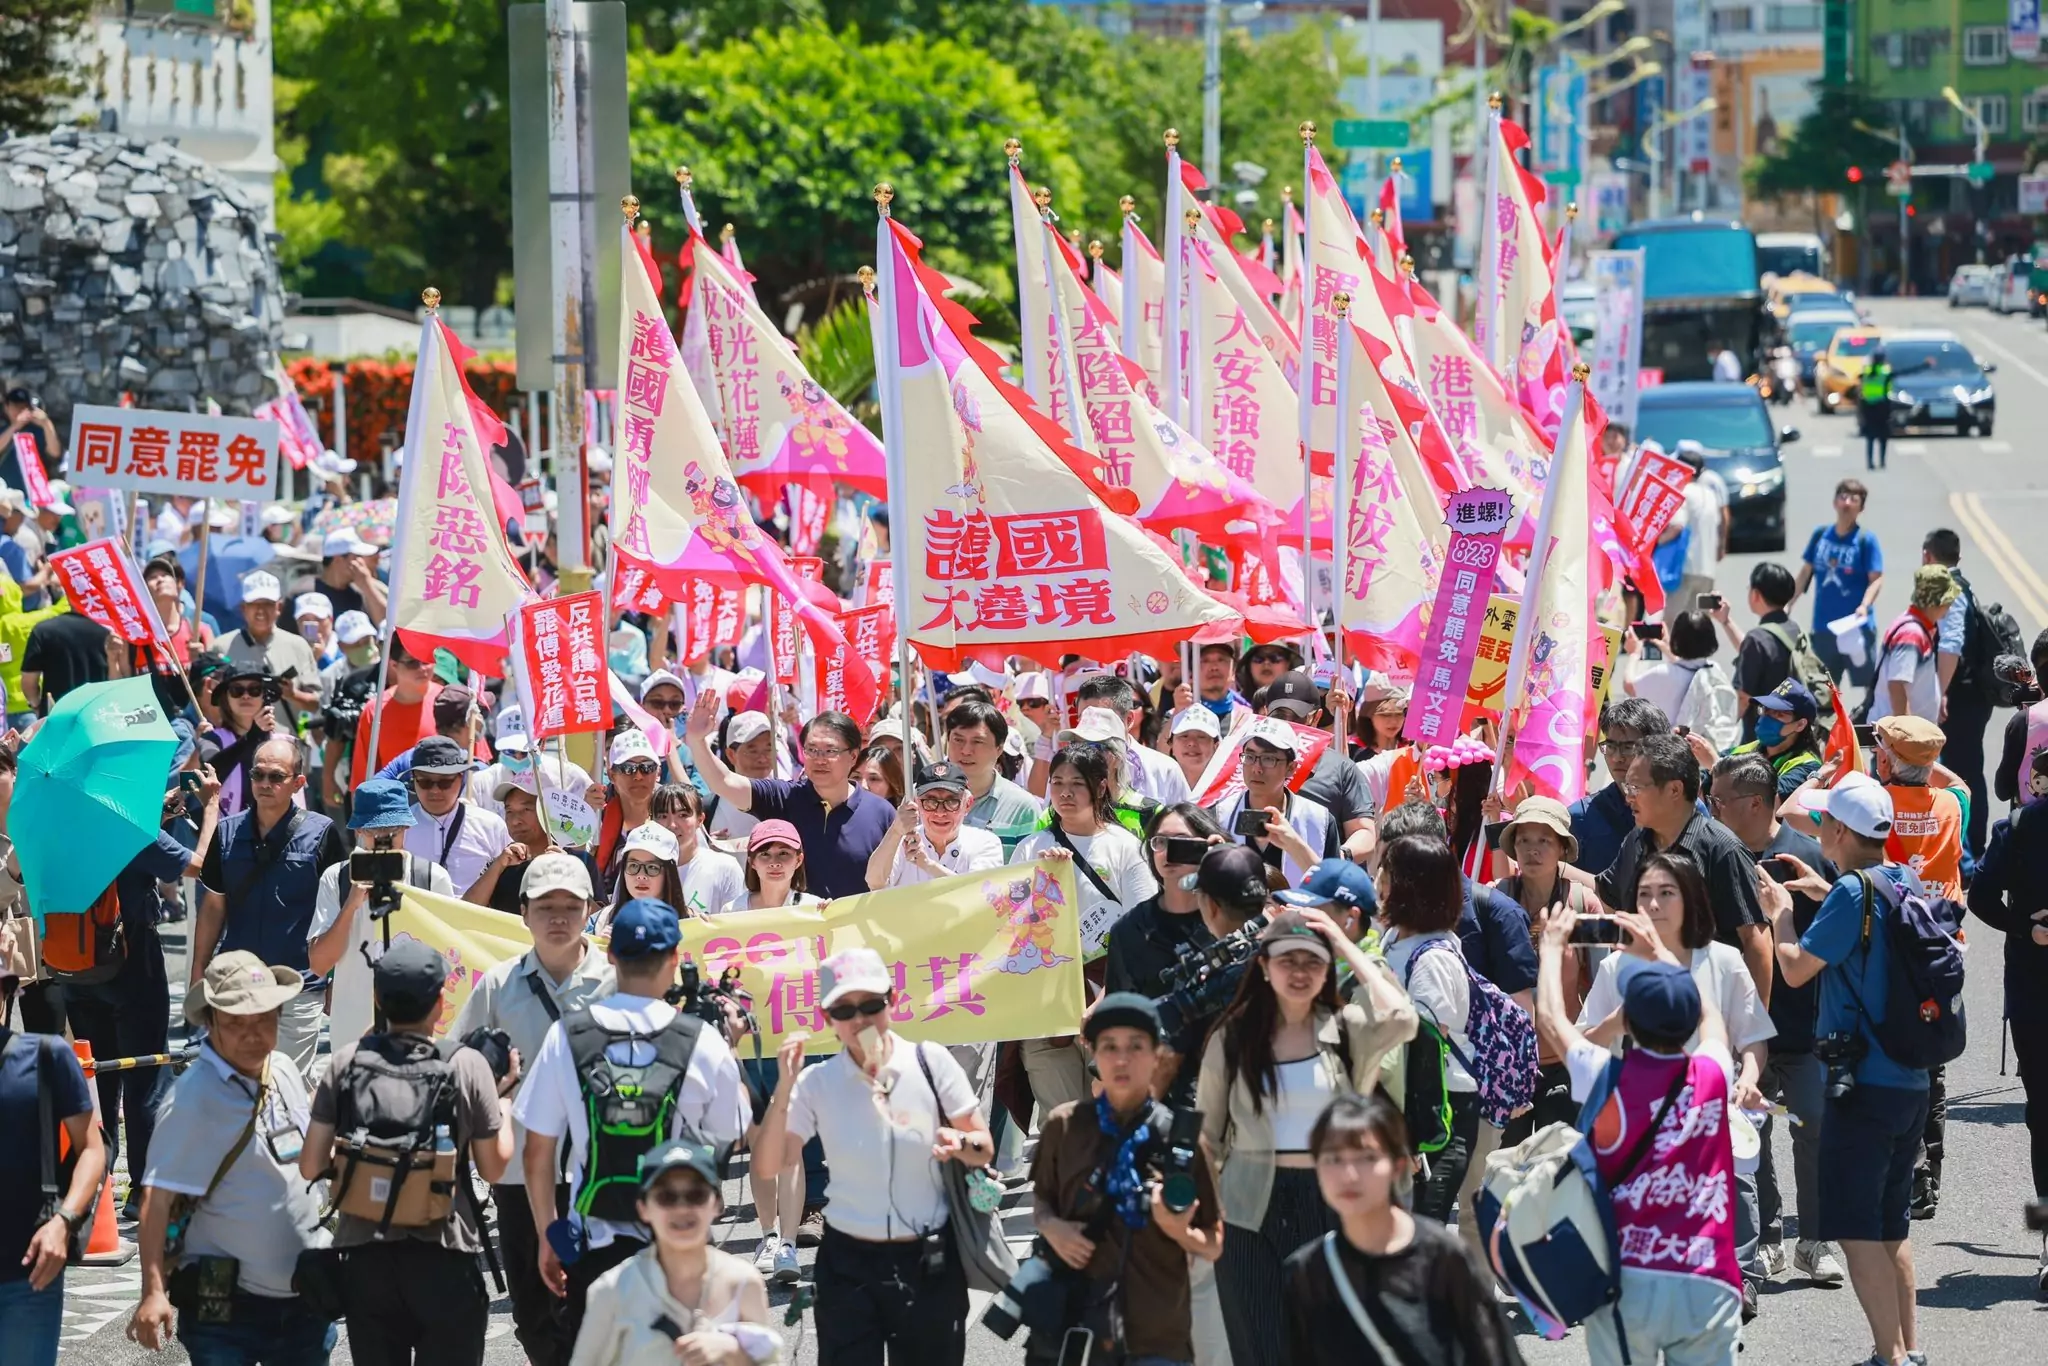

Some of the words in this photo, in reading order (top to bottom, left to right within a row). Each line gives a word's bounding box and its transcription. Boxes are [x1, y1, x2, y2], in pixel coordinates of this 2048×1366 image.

[1213, 304, 1264, 484] 大安強強
[75, 422, 268, 486] 同意罷免
[924, 507, 1112, 581] 護國
[1456, 501, 1504, 524] 進螺!
[1452, 538, 1496, 569] 823
[918, 578, 1116, 631] 大遶境
[1437, 569, 1478, 664] 同意罷免
[533, 606, 566, 730] 罷傅愛花蓮
[568, 600, 602, 725] 反共護台灣
[1419, 665, 1452, 738] 馬文君
